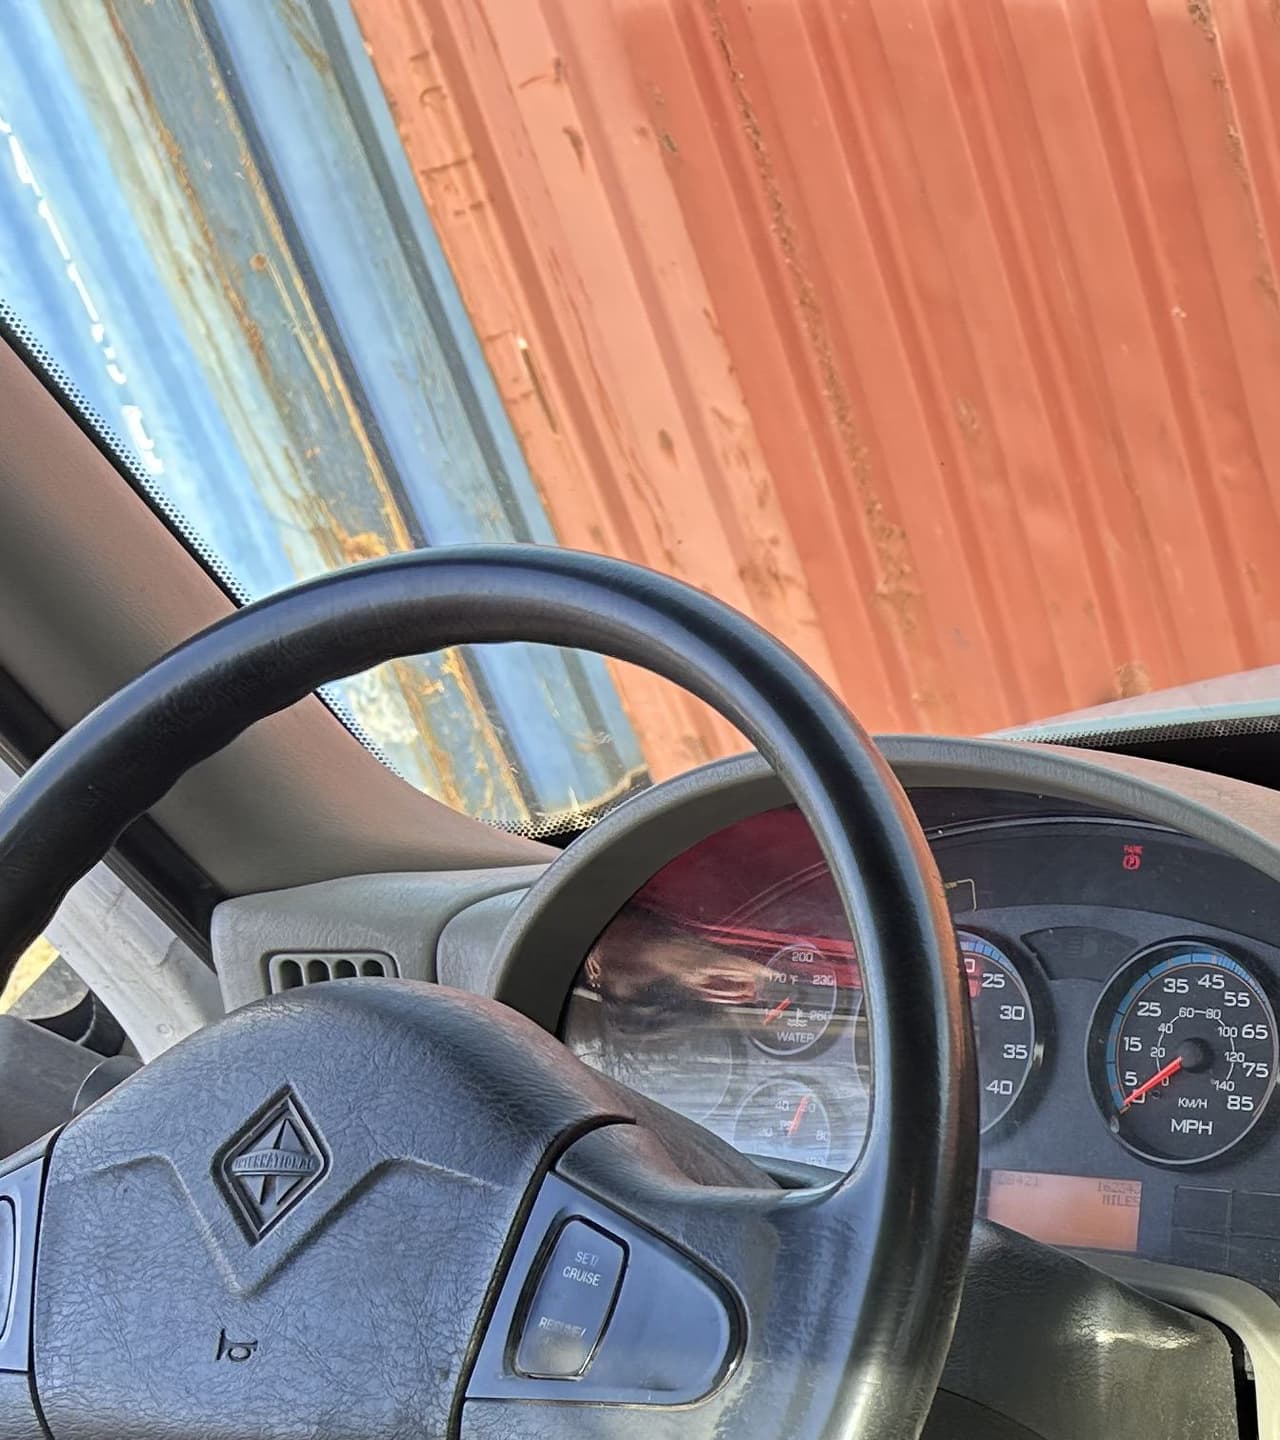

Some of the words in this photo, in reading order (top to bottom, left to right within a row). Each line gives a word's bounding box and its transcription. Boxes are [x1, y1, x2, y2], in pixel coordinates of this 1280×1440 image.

[792, 951, 814, 963] 200
[812, 974, 834, 986] 230
[982, 973, 1006, 988] 25
[1163, 978, 1189, 994] 35
[1198, 974, 1225, 989] 45
[1224, 992, 1250, 1008] 55
[1000, 1006, 1025, 1021] 30
[1137, 1002, 1162, 1017] 25
[1179, 1007, 1195, 1018] 60
[1205, 1008, 1221, 1020] 80
[1158, 1023, 1173, 1034] 40
[1218, 1026, 1238, 1038] 100
[1242, 1024, 1268, 1039] 65
[776, 1031, 815, 1043] WATER
[1124, 1037, 1142, 1051] 15
[1003, 1045, 1028, 1059] 35
[1151, 1047, 1165, 1058] 20
[1225, 1052, 1245, 1063] 120
[1242, 1063, 1269, 1078] 75
[1125, 1072, 1138, 1086] 5
[1214, 1080, 1235, 1091] 140
[985, 1079, 1013, 1095] 40
[1178, 1097, 1208, 1109] KM/H
[1227, 1095, 1254, 1111] 85
[1171, 1119, 1213, 1135] MPH
[234, 1152, 314, 1169] INTERNATIONAL
[562, 1265, 601, 1287] CRUISE
